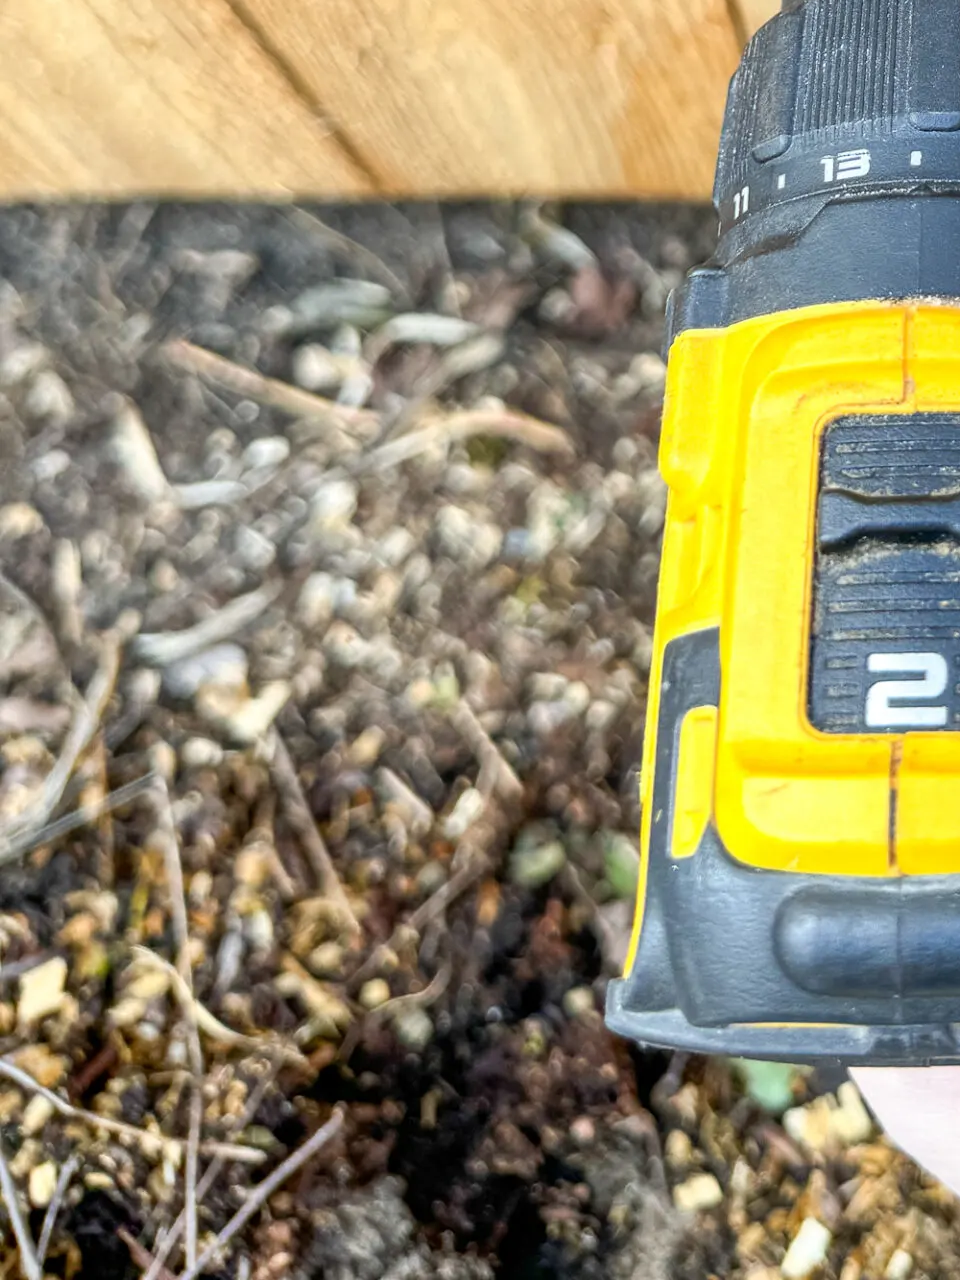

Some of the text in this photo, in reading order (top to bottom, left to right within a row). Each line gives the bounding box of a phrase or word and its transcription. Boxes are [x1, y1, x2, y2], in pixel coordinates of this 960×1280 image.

[732, 185, 750, 220] 11
[819, 148, 871, 182] 13
[865, 652, 948, 727] 2
